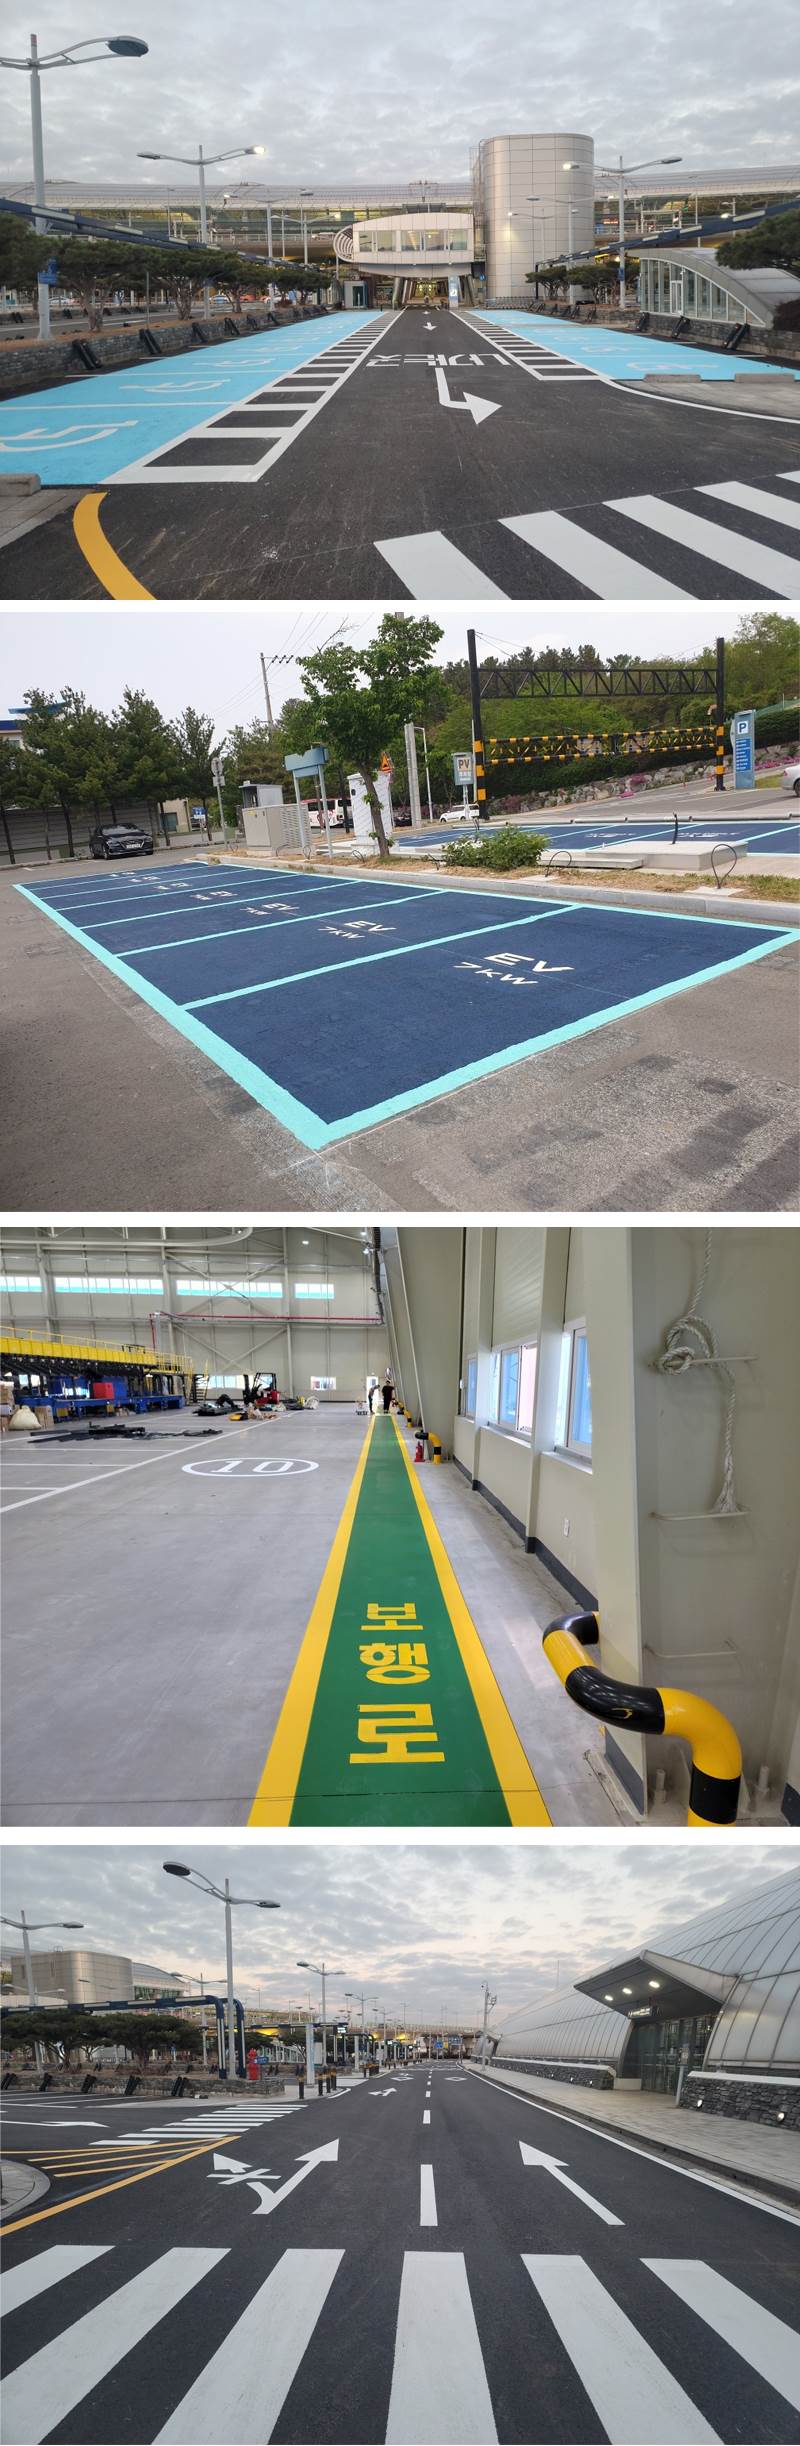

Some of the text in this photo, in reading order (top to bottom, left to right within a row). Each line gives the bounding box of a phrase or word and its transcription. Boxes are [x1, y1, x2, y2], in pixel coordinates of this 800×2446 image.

[365, 353, 511, 367] 나가는곳
[739, 723, 747, 733] P
[344, 920, 397, 933] EV
[483, 952, 575, 973] EV
[212, 1460, 294, 1473] 10
[349, 1603, 446, 1764] 보행로
